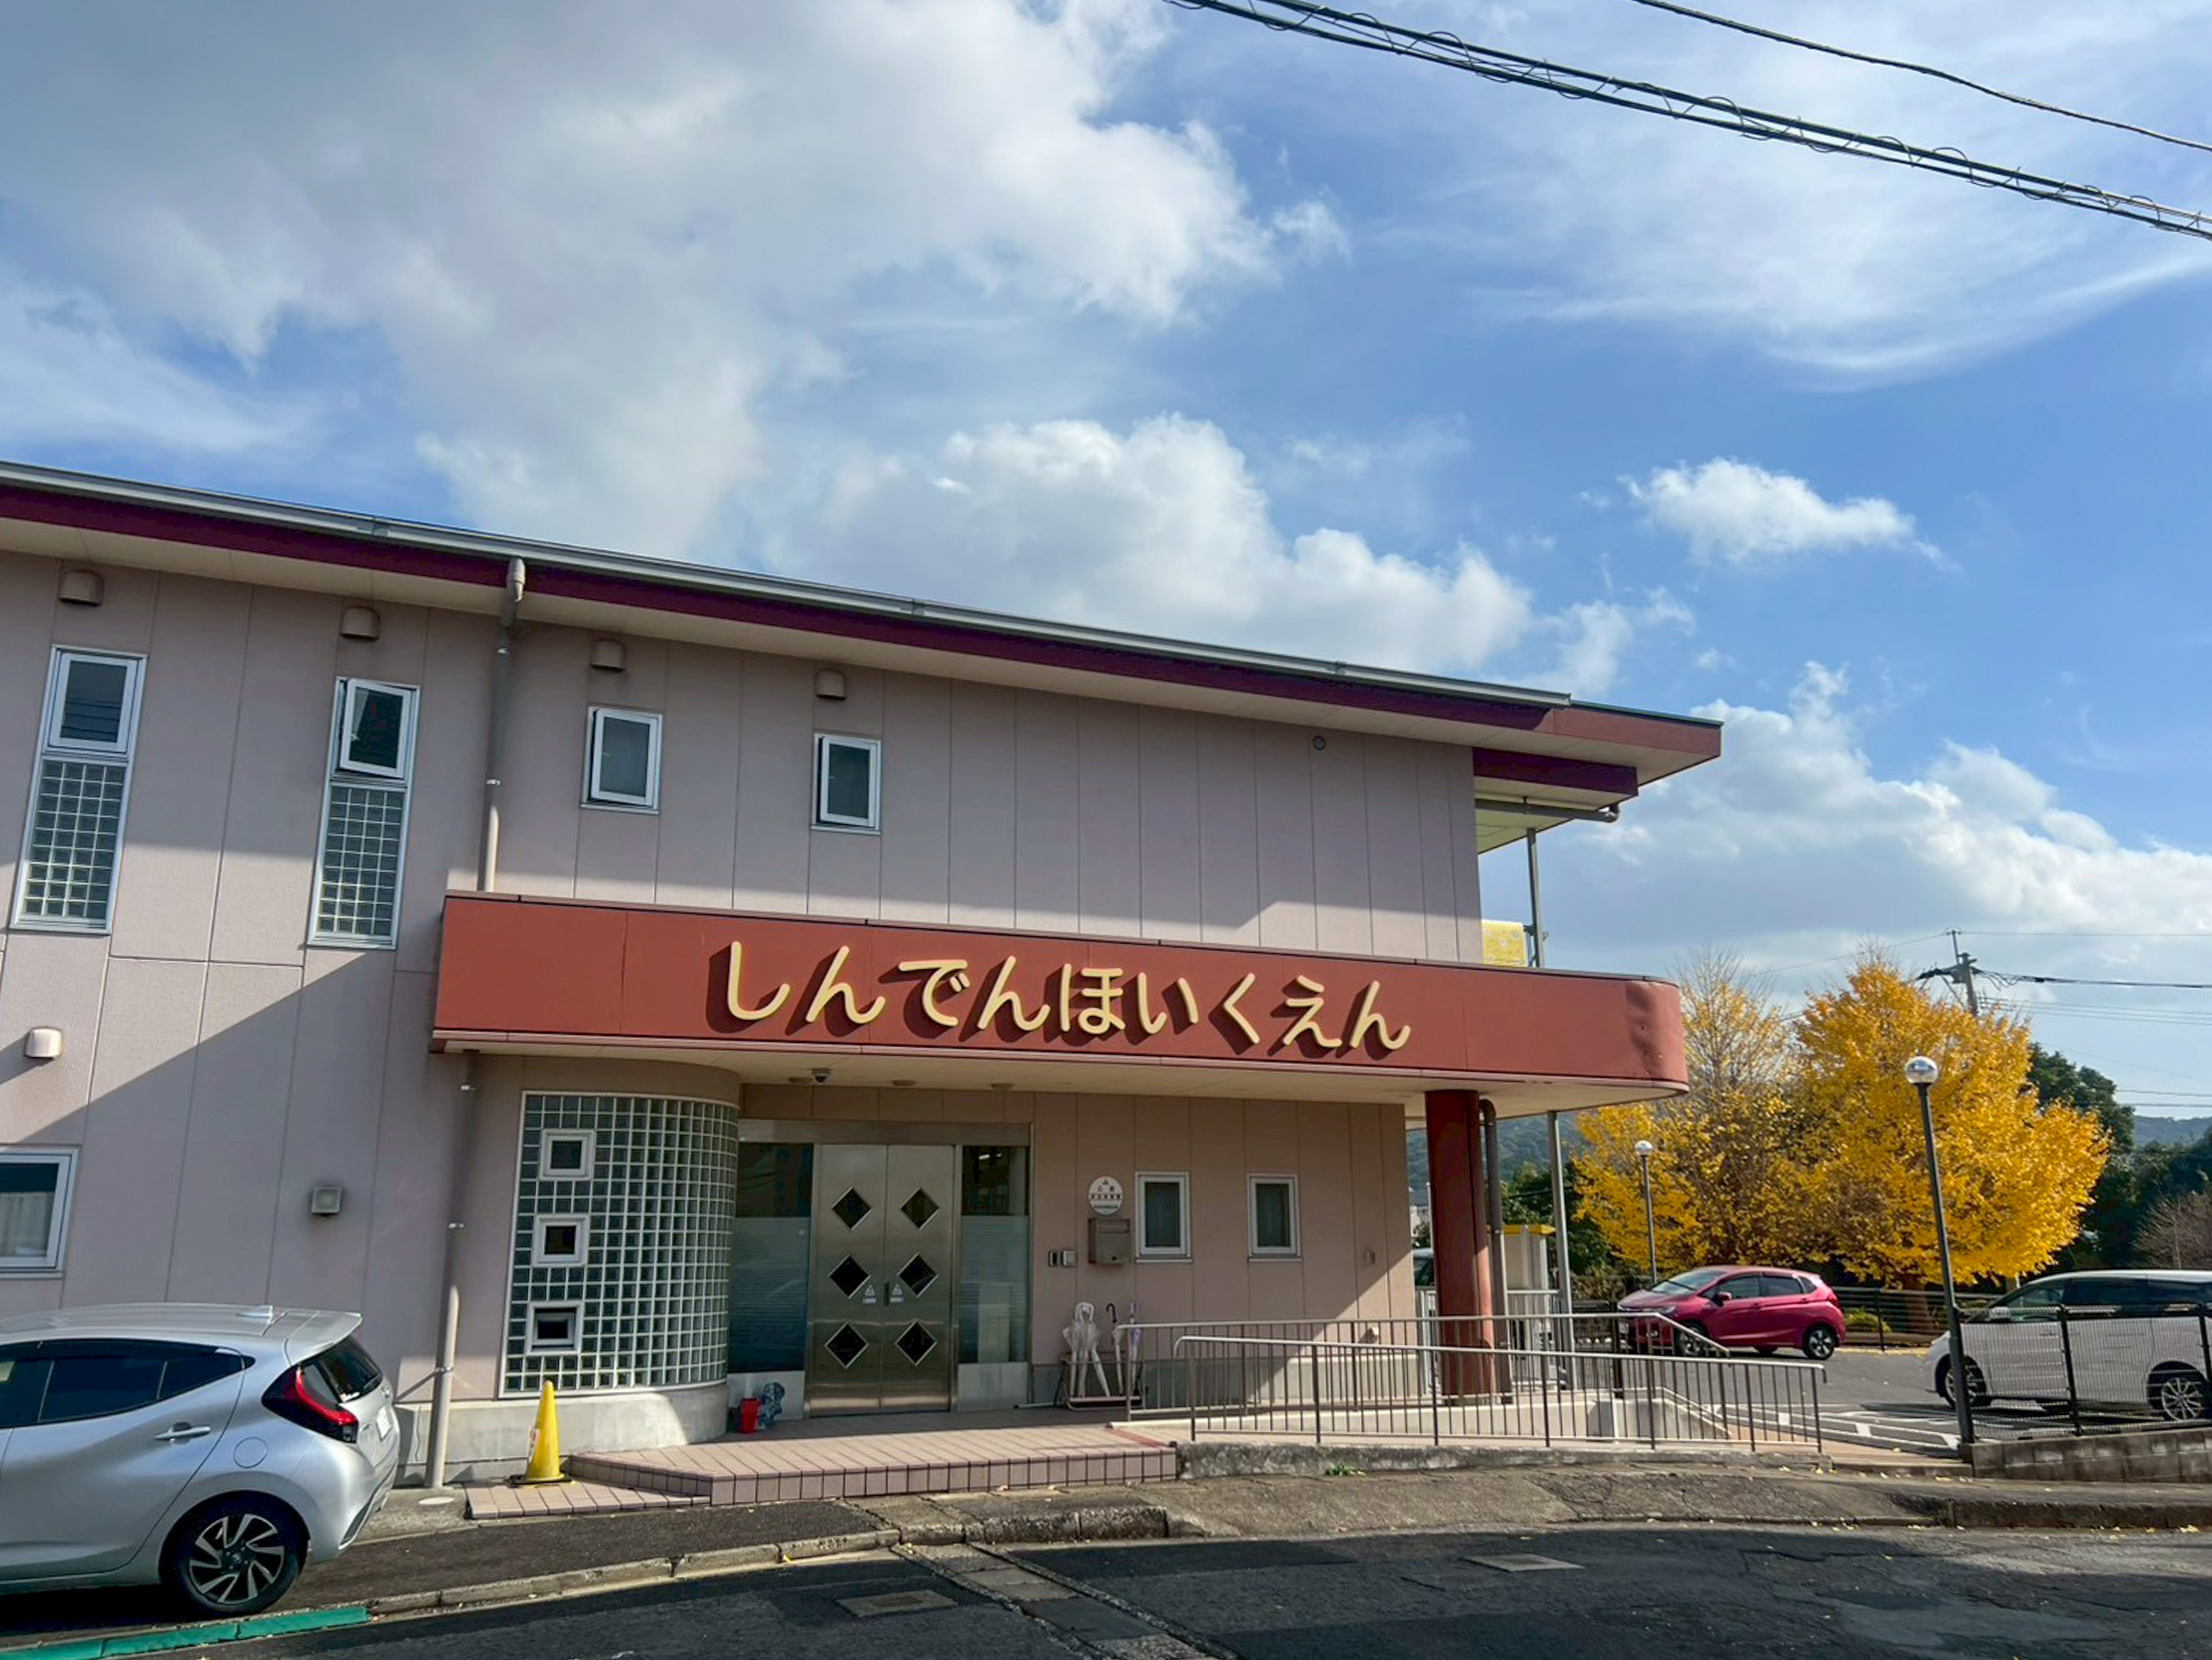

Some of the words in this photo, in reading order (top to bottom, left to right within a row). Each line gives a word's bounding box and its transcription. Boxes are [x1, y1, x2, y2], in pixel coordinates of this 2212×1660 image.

[727, 940, 1411, 1050] しんでんほいくえん
